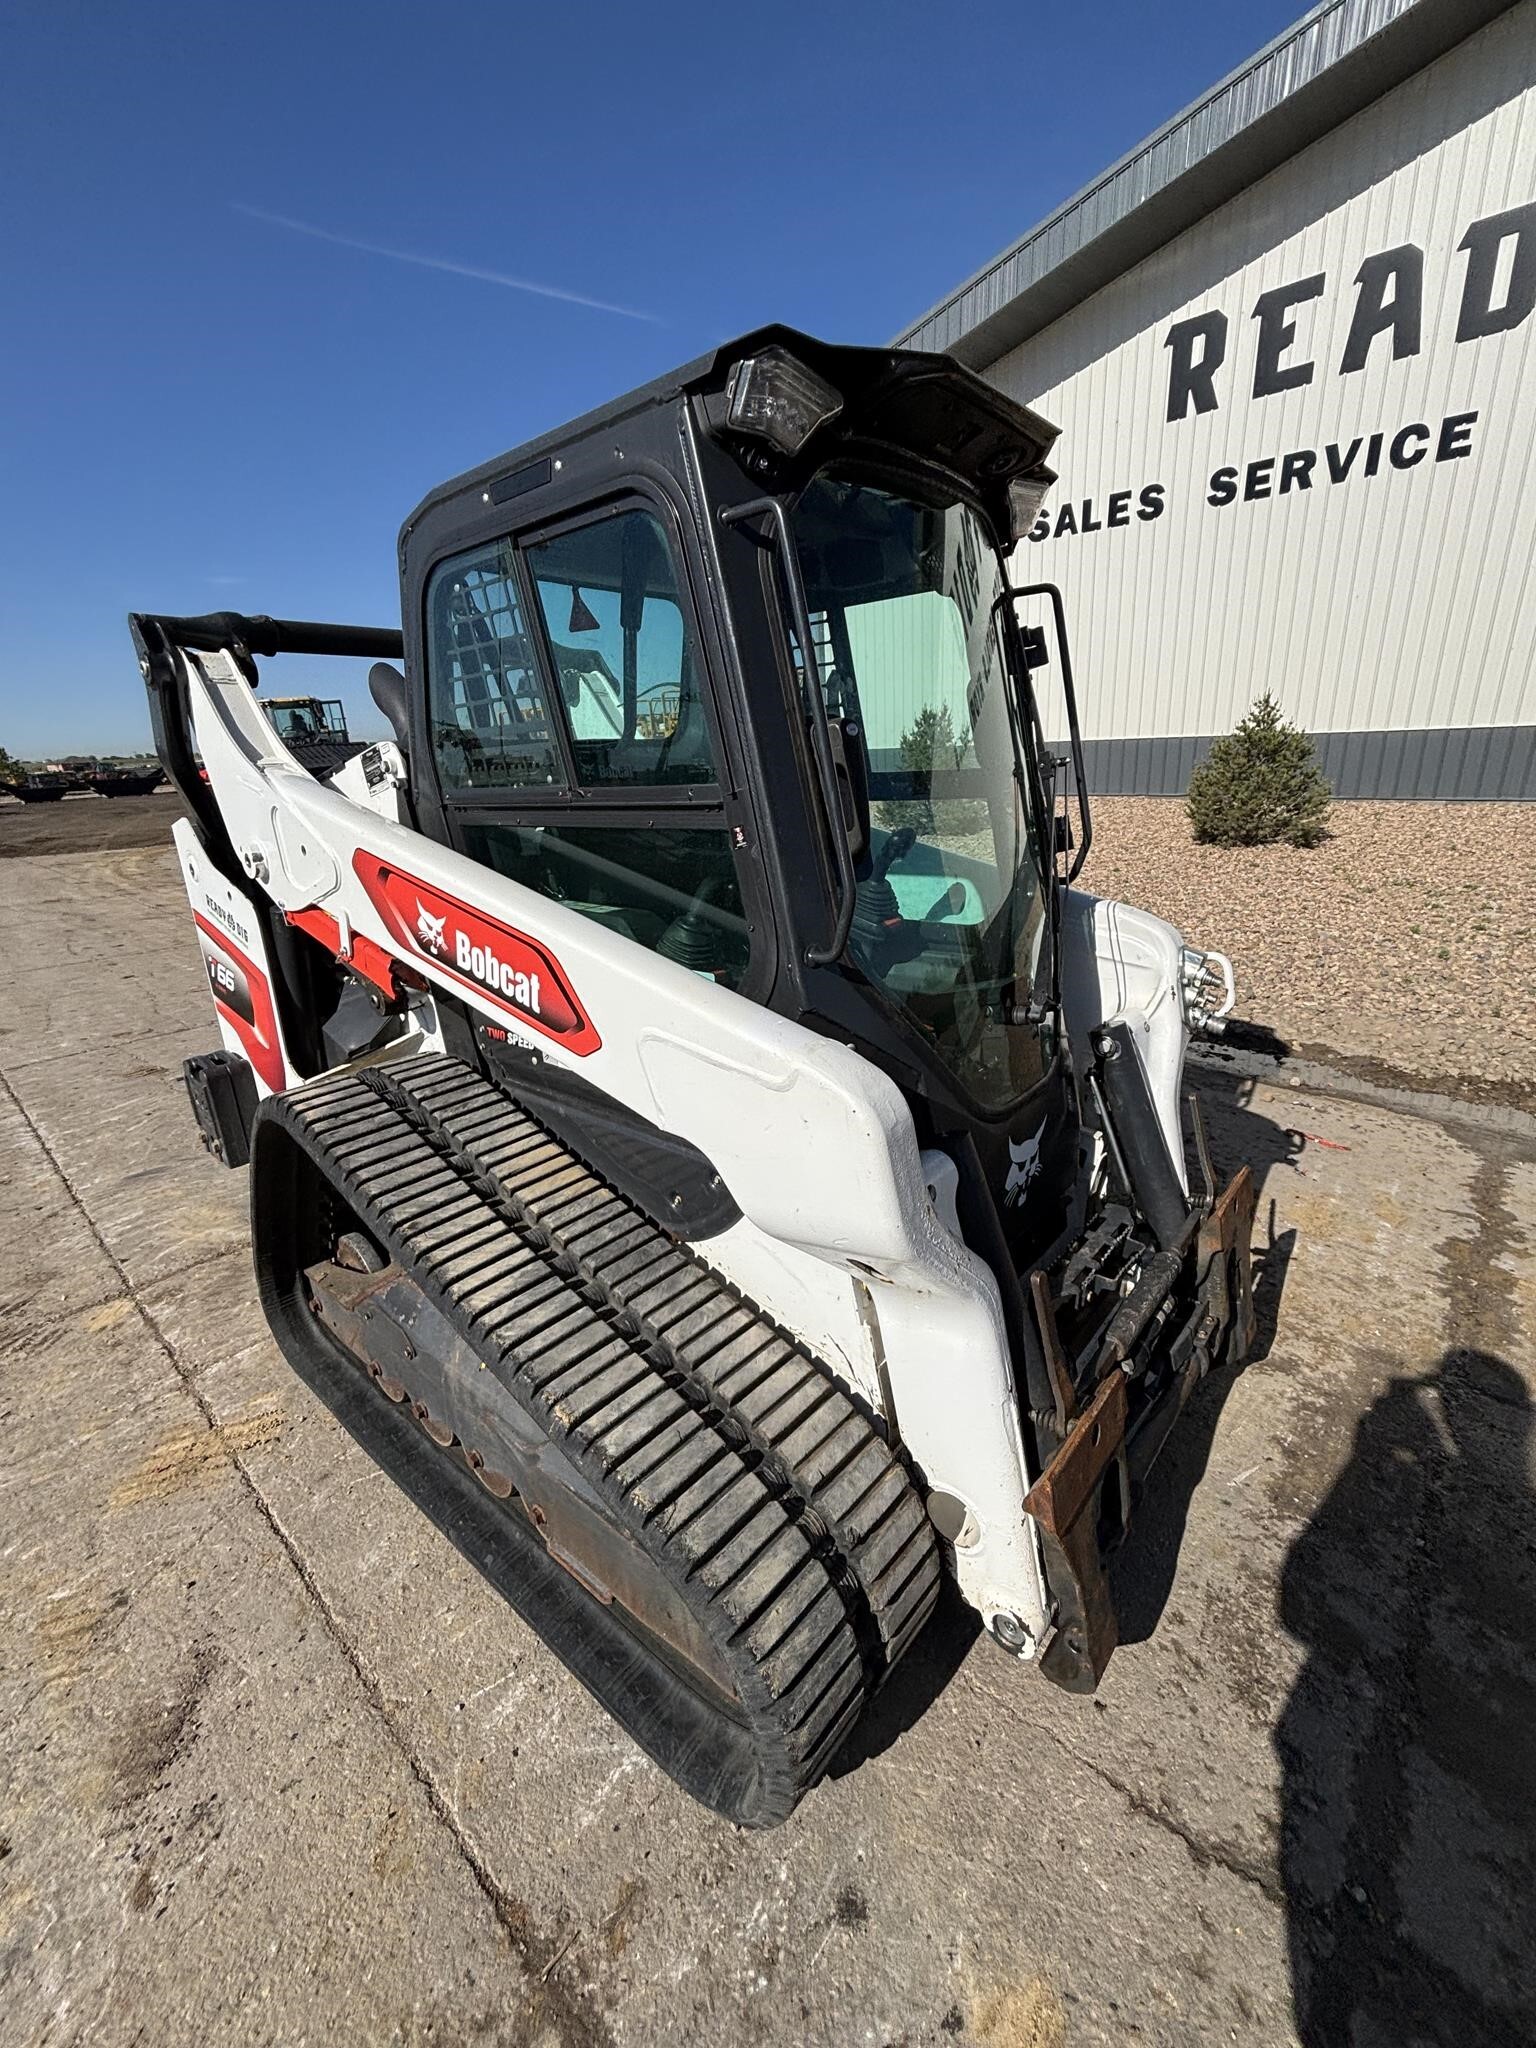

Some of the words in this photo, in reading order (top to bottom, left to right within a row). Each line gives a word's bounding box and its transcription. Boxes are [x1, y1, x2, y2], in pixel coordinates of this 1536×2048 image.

[1028, 483, 1166, 543] SALES
[1206, 410, 1479, 508] SERVICE
[455, 928, 541, 1015] Bobcat
[486, 1026, 506, 1041] TWO
[507, 1031, 535, 1050] SPEED
